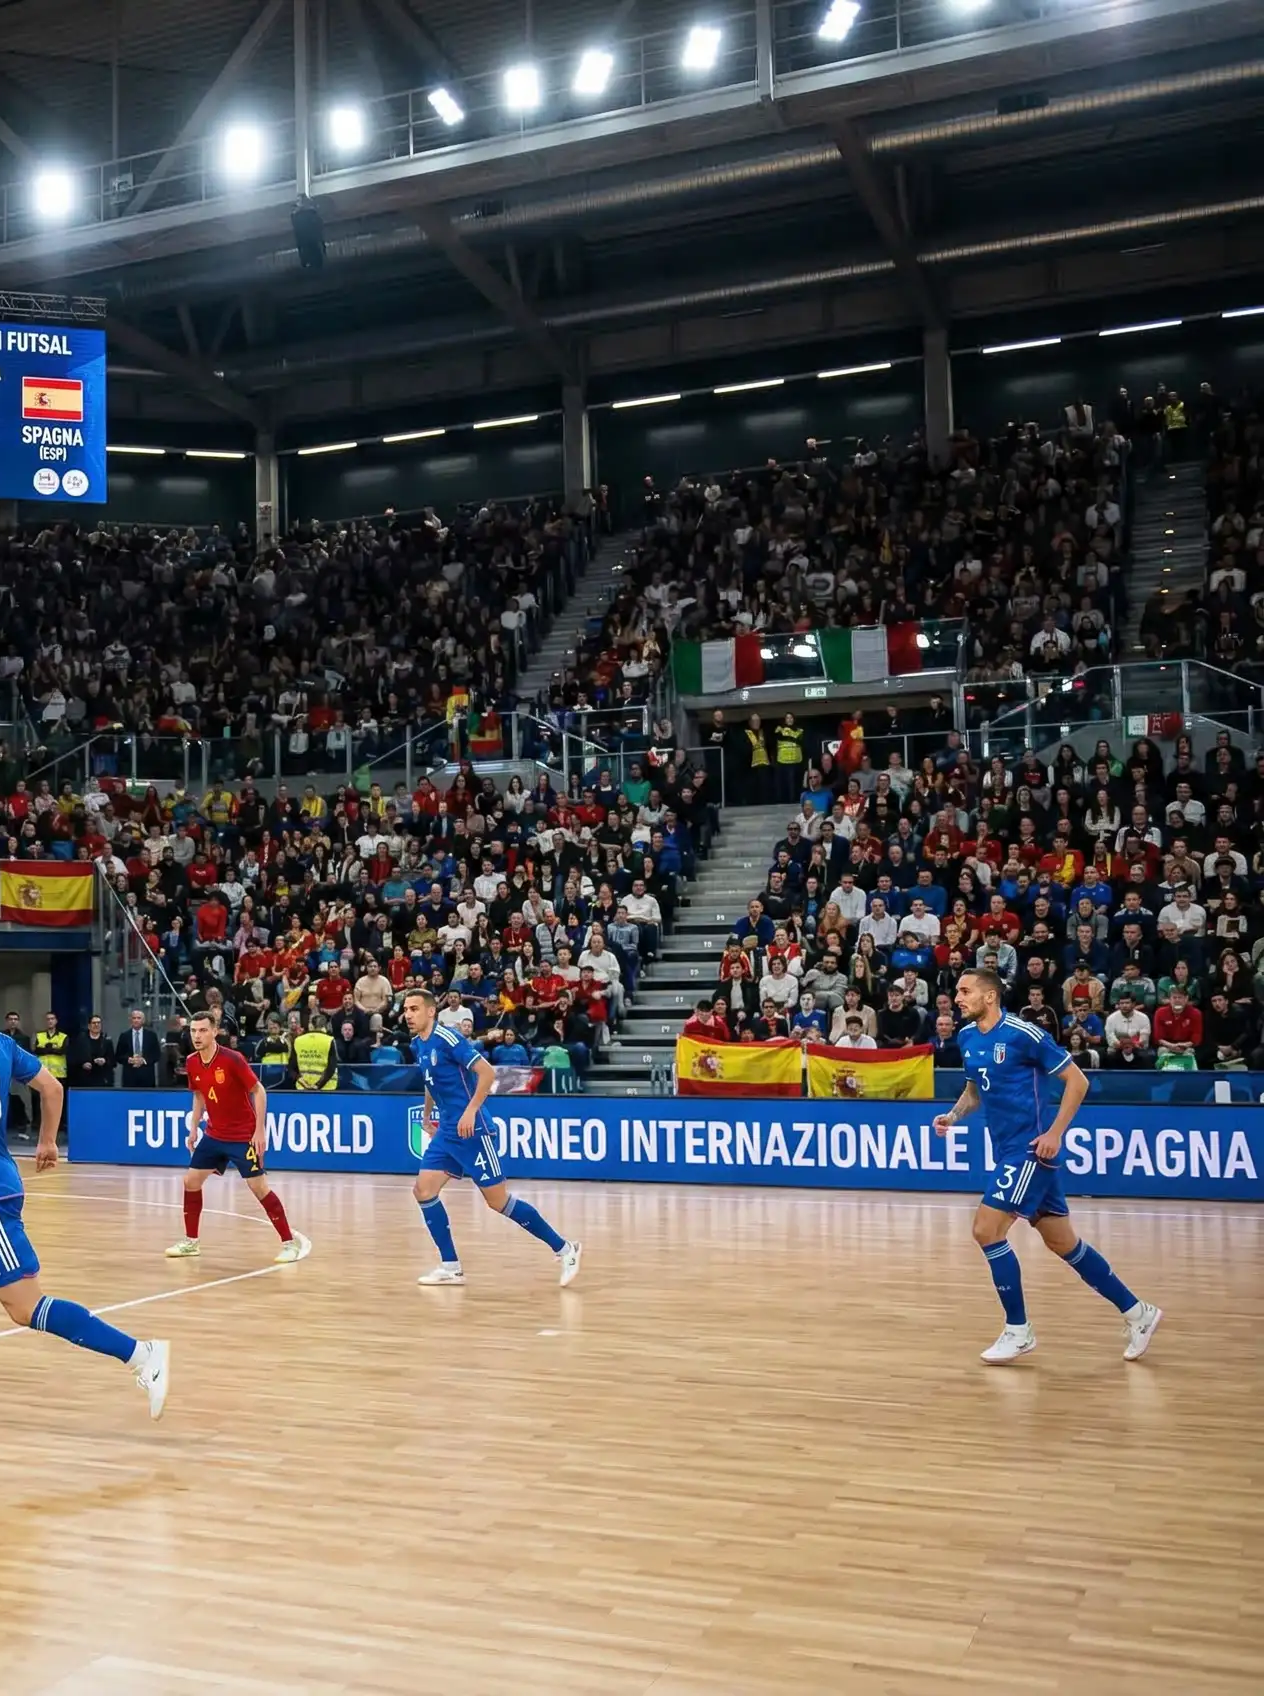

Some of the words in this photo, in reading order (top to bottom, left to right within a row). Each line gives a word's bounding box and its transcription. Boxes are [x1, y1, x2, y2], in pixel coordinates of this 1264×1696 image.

[7, 331, 73, 356] FUTSAL
[22, 425, 84, 447] SPAGNA
[39, 446, 67, 462] (ESP)
[425, 1068, 434, 1086] 4
[978, 1067, 990, 1092] 3
[208, 1086, 218, 1103] 4
[263, 1112, 374, 1155] WORLD
[246, 1146, 258, 1163] 4
[492, 1116, 607, 1161] ORNEO
[622, 1118, 969, 1172] INTERNAZIONALE
[1065, 1127, 1258, 1180] SPAGNA
[474, 1151, 487, 1170] 4
[996, 1164, 1017, 1189] 3
